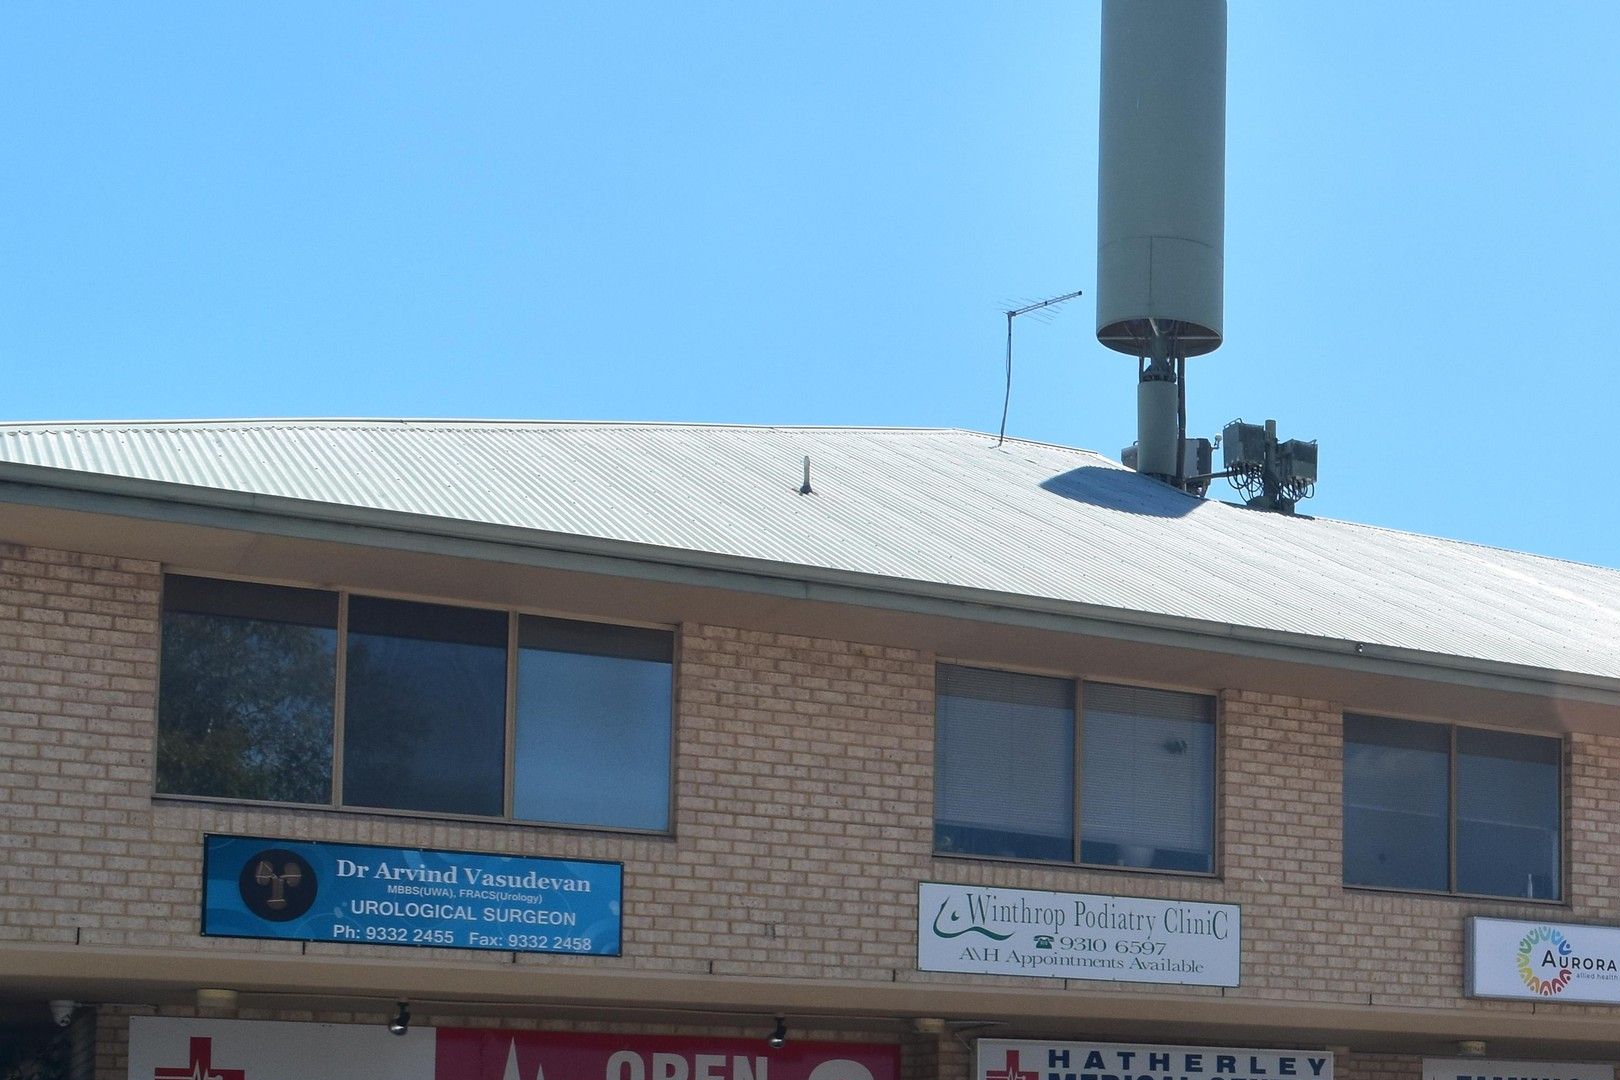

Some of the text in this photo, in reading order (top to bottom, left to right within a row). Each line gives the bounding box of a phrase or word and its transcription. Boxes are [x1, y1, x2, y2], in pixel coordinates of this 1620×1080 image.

[337, 859, 591, 893] Dr Arvind Vasudevan
[387, 884, 543, 904] MBBS(UWA), FRACS(Urology)
[350, 900, 577, 927] UROLOGICAL SURGEON
[966, 893, 1066, 934] Winthrop
[1073, 901, 1156, 940] Podiatry
[333, 923, 592, 952] Ph: 9332 2455 Fax: 9332 2458
[1060, 936, 1167, 956] 9310 6597
[1005, 949, 1125, 970] Appointments
[1128, 956, 1205, 974] Available
[1576, 971, 1619, 982] allied health
[1048, 1049, 1326, 1076] HATHERLEY
